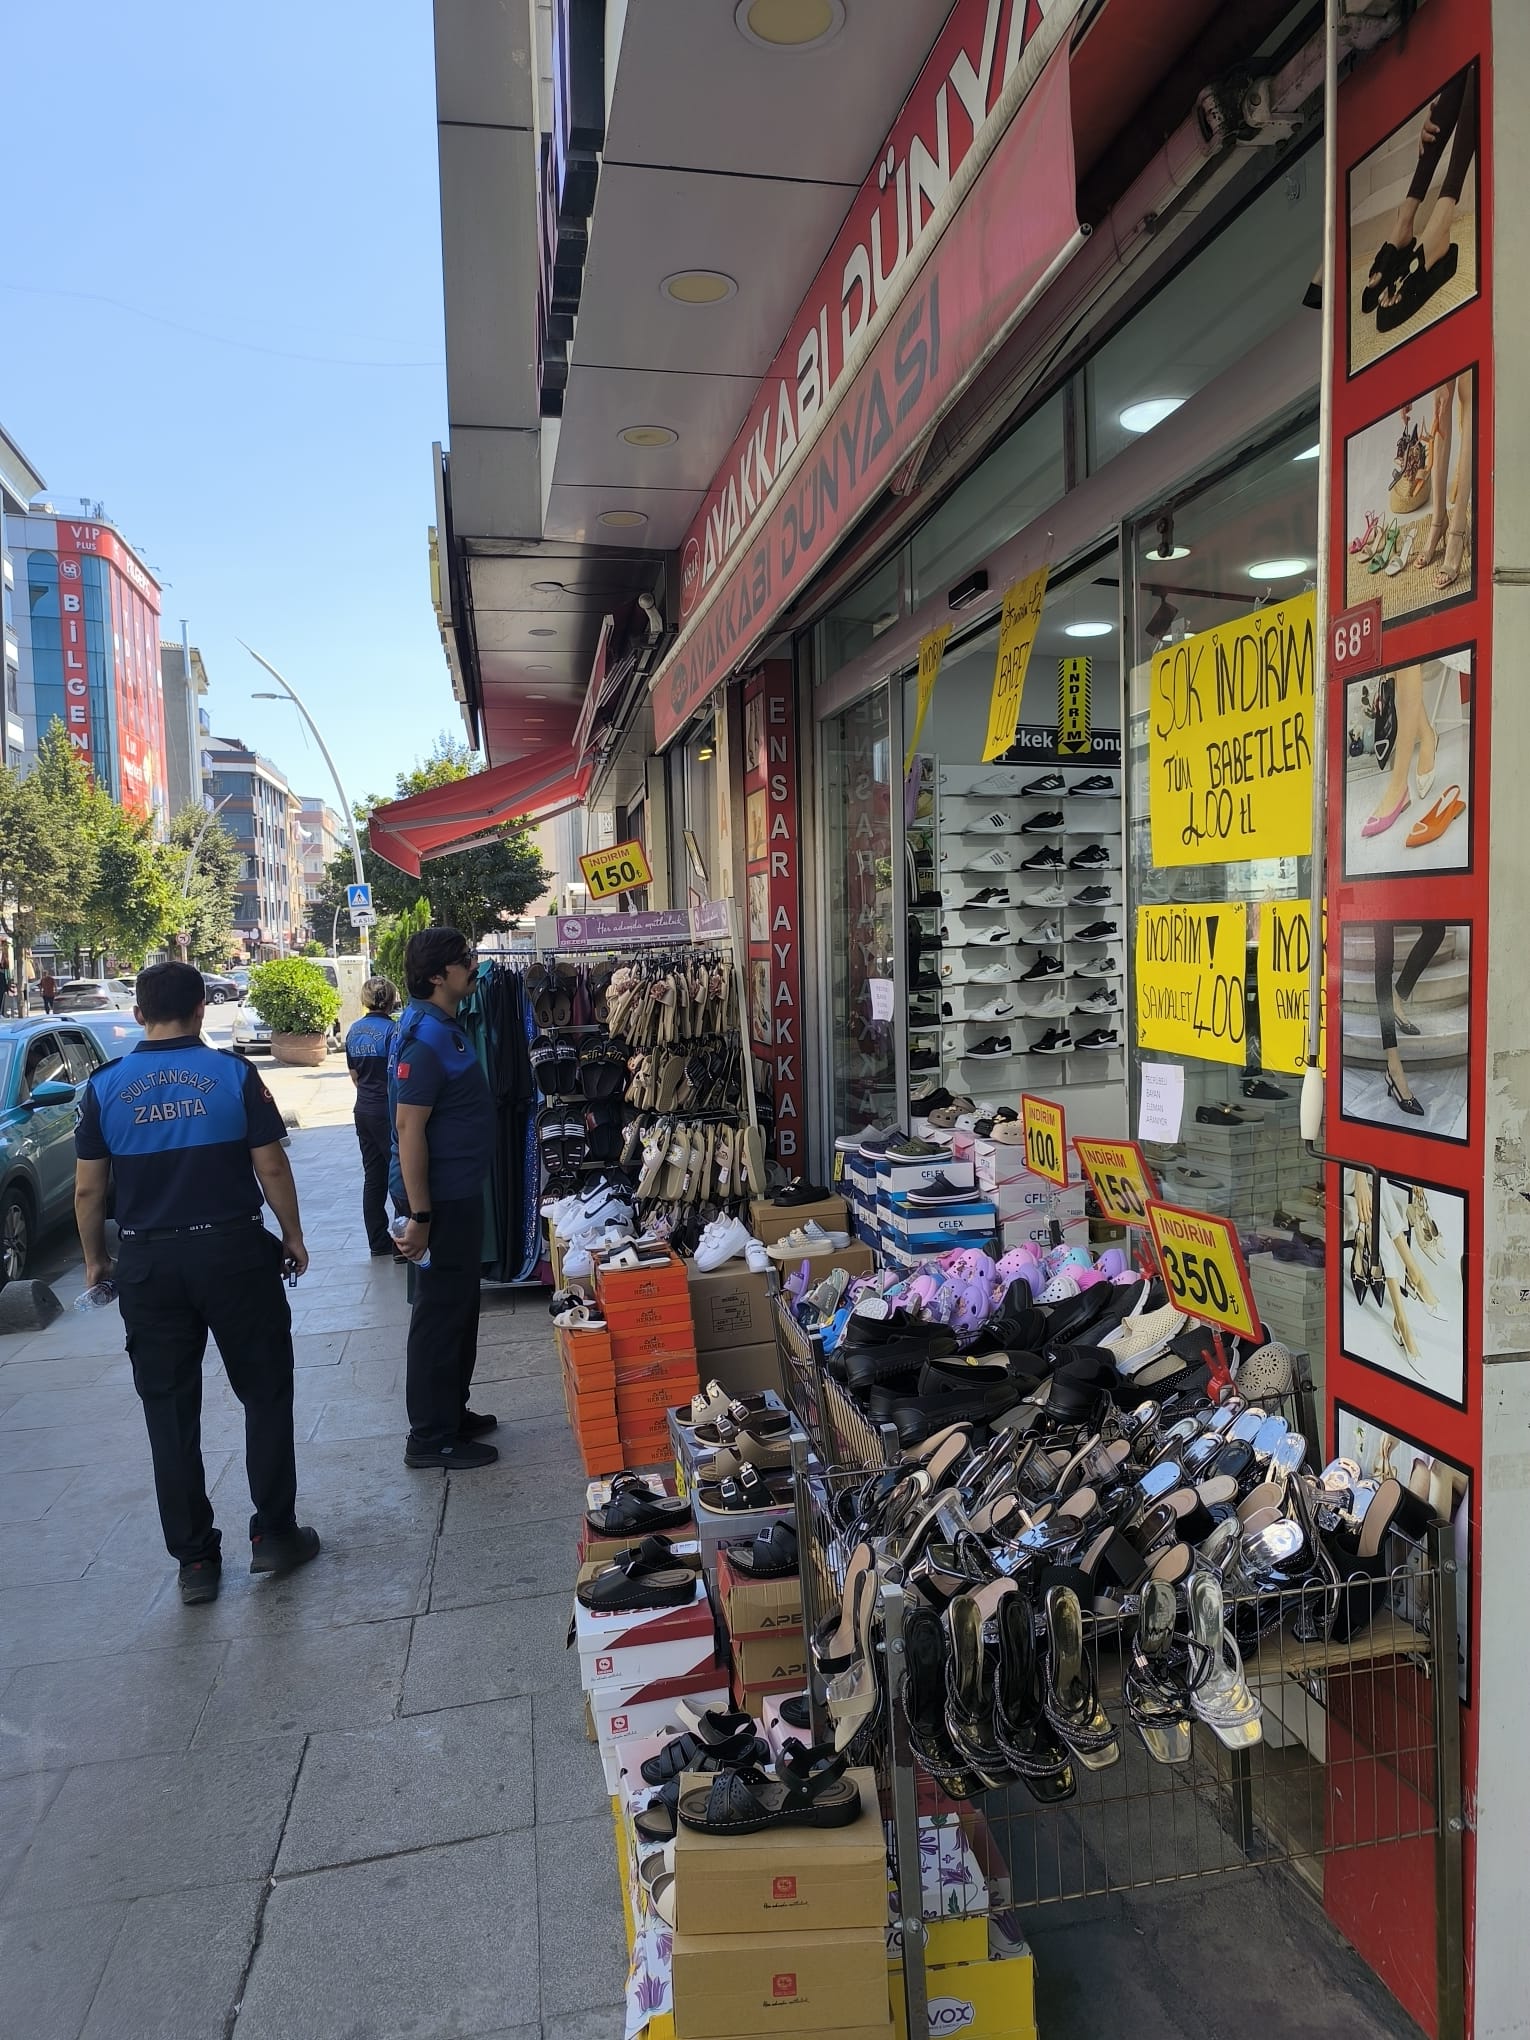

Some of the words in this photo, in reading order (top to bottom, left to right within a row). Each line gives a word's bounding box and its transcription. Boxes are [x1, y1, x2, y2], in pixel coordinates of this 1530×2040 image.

[702, 303, 830, 588] AYAKKABI
[688, 536, 772, 693] AYAKKABI
[781, 277, 940, 580] DÜNYASI
[70, 525, 100, 540] VIP
[76, 541, 97, 551] PLUS
[1156, 644, 1204, 742] ŞOK
[1212, 610, 1315, 717] İNDİRİM
[1067, 659, 1082, 740] İNDİRİM
[1014, 730, 1053, 747] rkek
[1163, 749, 1193, 792] TÜM
[1206, 711, 1312, 790] BABETLER
[769, 696, 790, 878] ENSAR
[588, 848, 630, 868] İNDİRİM
[1142, 983, 1193, 1023] SANDALET
[1193, 974, 1245, 1044] 400
[120, 1068, 219, 1104] SULTANGAZİ
[134, 1098, 207, 1125] ZABITA
[1028, 1105, 1056, 1127] İNDİRİM
[1083, 1146, 1126, 1169] İNDİRİM
[1093, 1171, 1145, 1218] 150
[938, 1219, 963, 1229] CFLEX
[1029, 1228, 1065, 1240] CFLX
[1158, 1212, 1217, 1249] İNDİRİM
